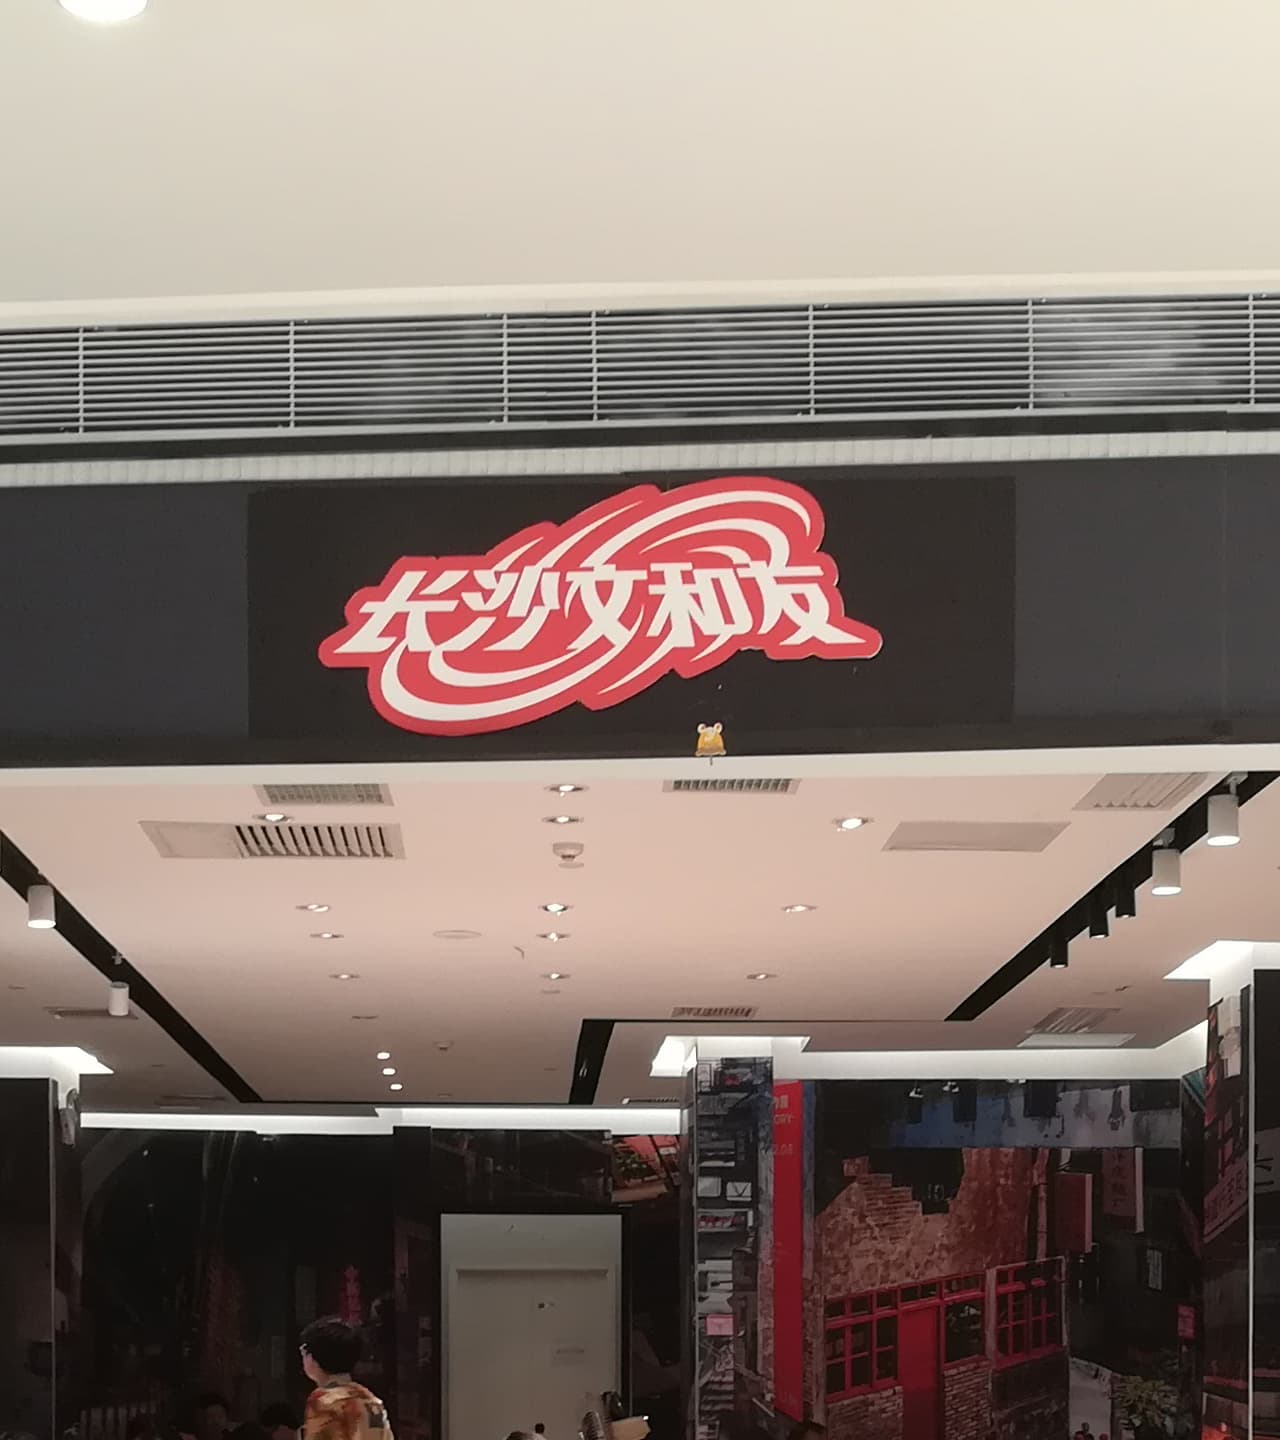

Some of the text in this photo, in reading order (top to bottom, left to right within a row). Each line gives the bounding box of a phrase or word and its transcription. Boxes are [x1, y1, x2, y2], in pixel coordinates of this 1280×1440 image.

[334, 530, 870, 680] 长沙文和友
